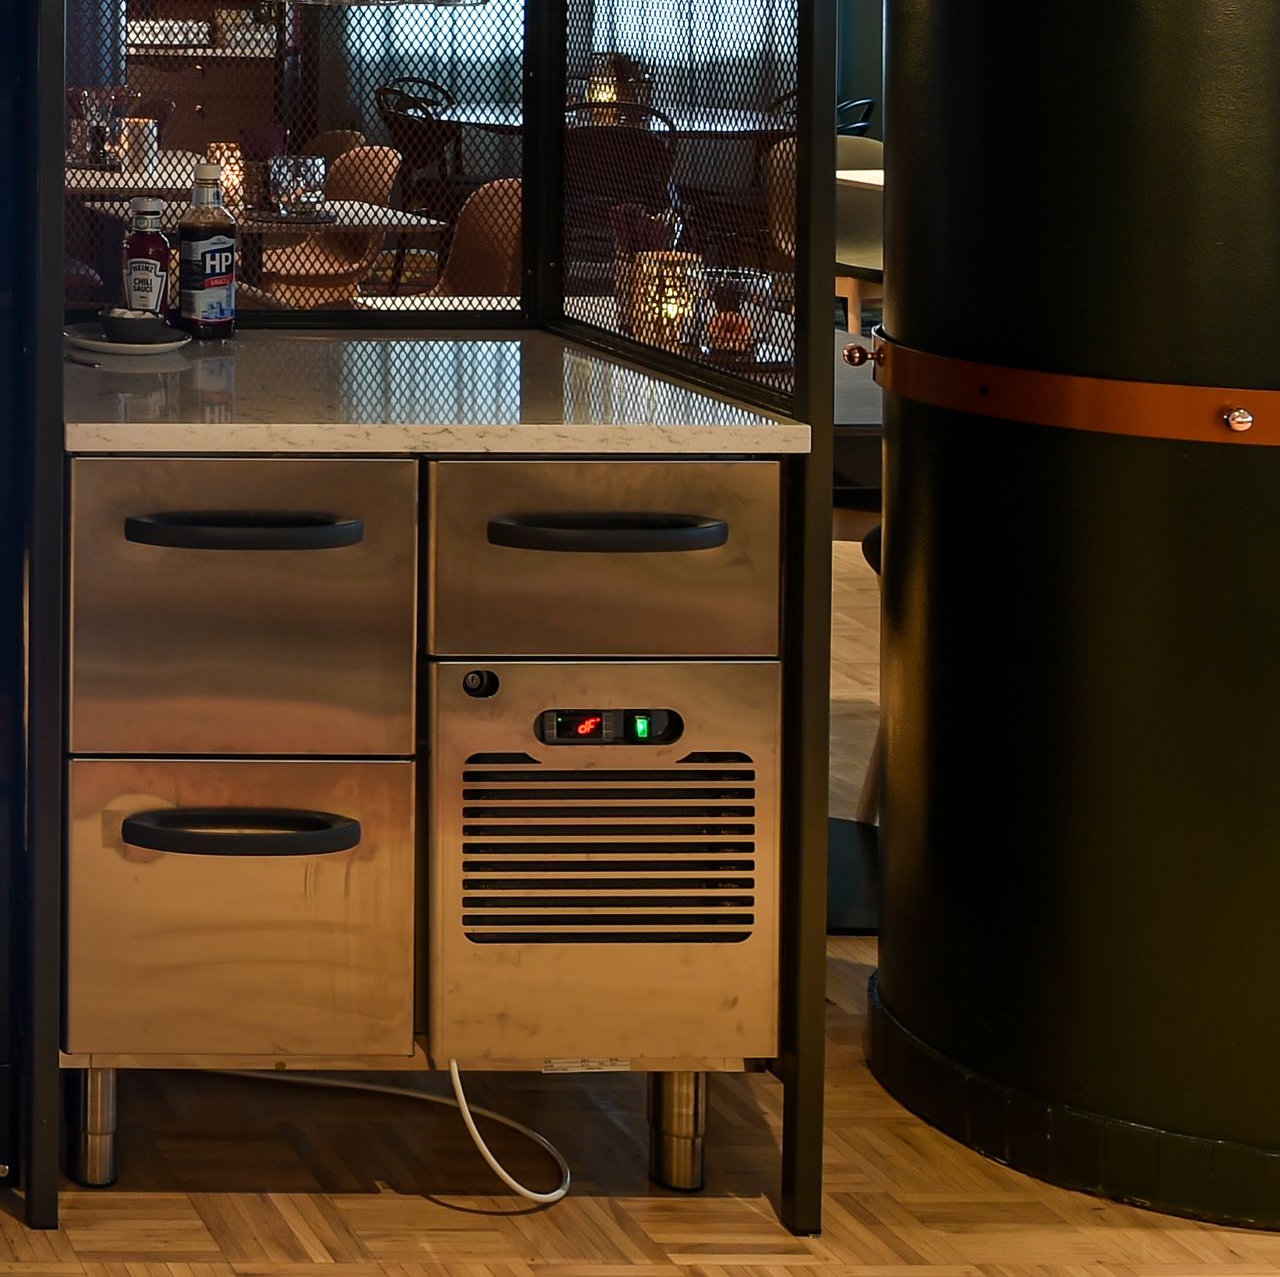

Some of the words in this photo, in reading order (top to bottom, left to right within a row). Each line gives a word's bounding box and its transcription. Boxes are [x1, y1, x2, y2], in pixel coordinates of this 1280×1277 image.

[205, 252, 232, 274] HP
[131, 264, 154, 274] HEINZ
[133, 277, 153, 286] CHILI
